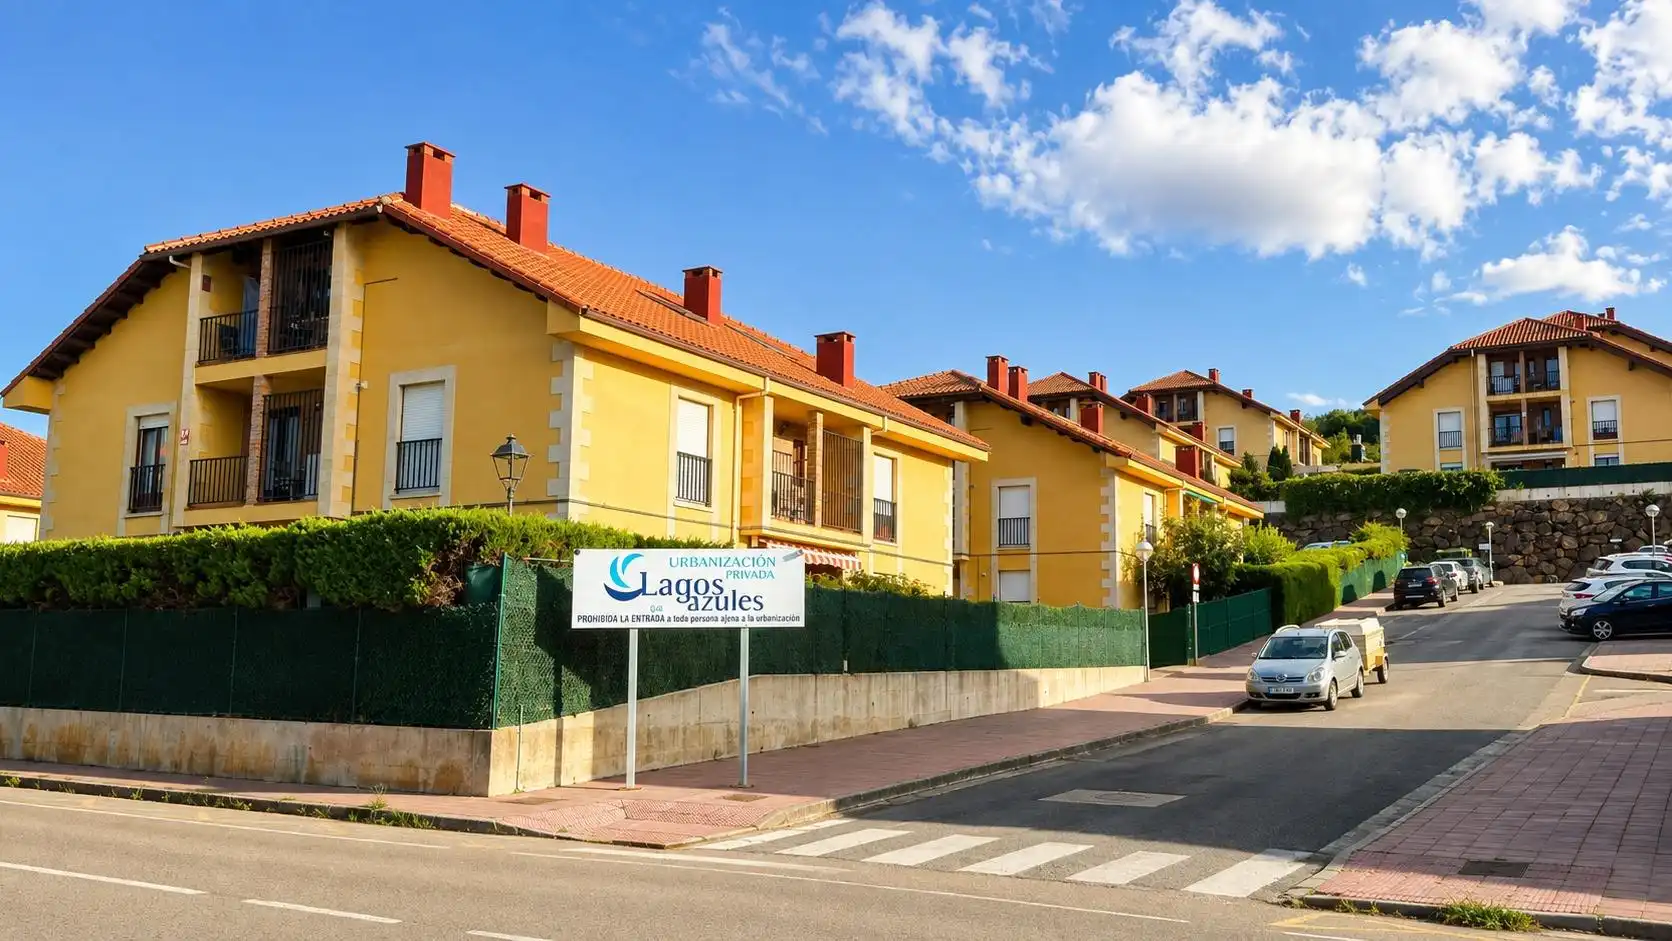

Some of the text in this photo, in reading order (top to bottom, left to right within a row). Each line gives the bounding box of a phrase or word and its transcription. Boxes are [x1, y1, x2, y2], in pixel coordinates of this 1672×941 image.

[669, 554, 776, 568] URBANIZACIÓN
[725, 569, 775, 580] PRIVADA
[639, 571, 724, 604] Lagos
[687, 589, 764, 612] azules
[577, 614, 618, 623] PROHIBIDA
[620, 614, 629, 623] LA
[631, 614, 665, 623] ENTRADA
[673, 614, 689, 622] toda
[720, 614, 739, 624] ajena
[747, 614, 754, 622] la
[755, 614, 800, 622] urbanización
